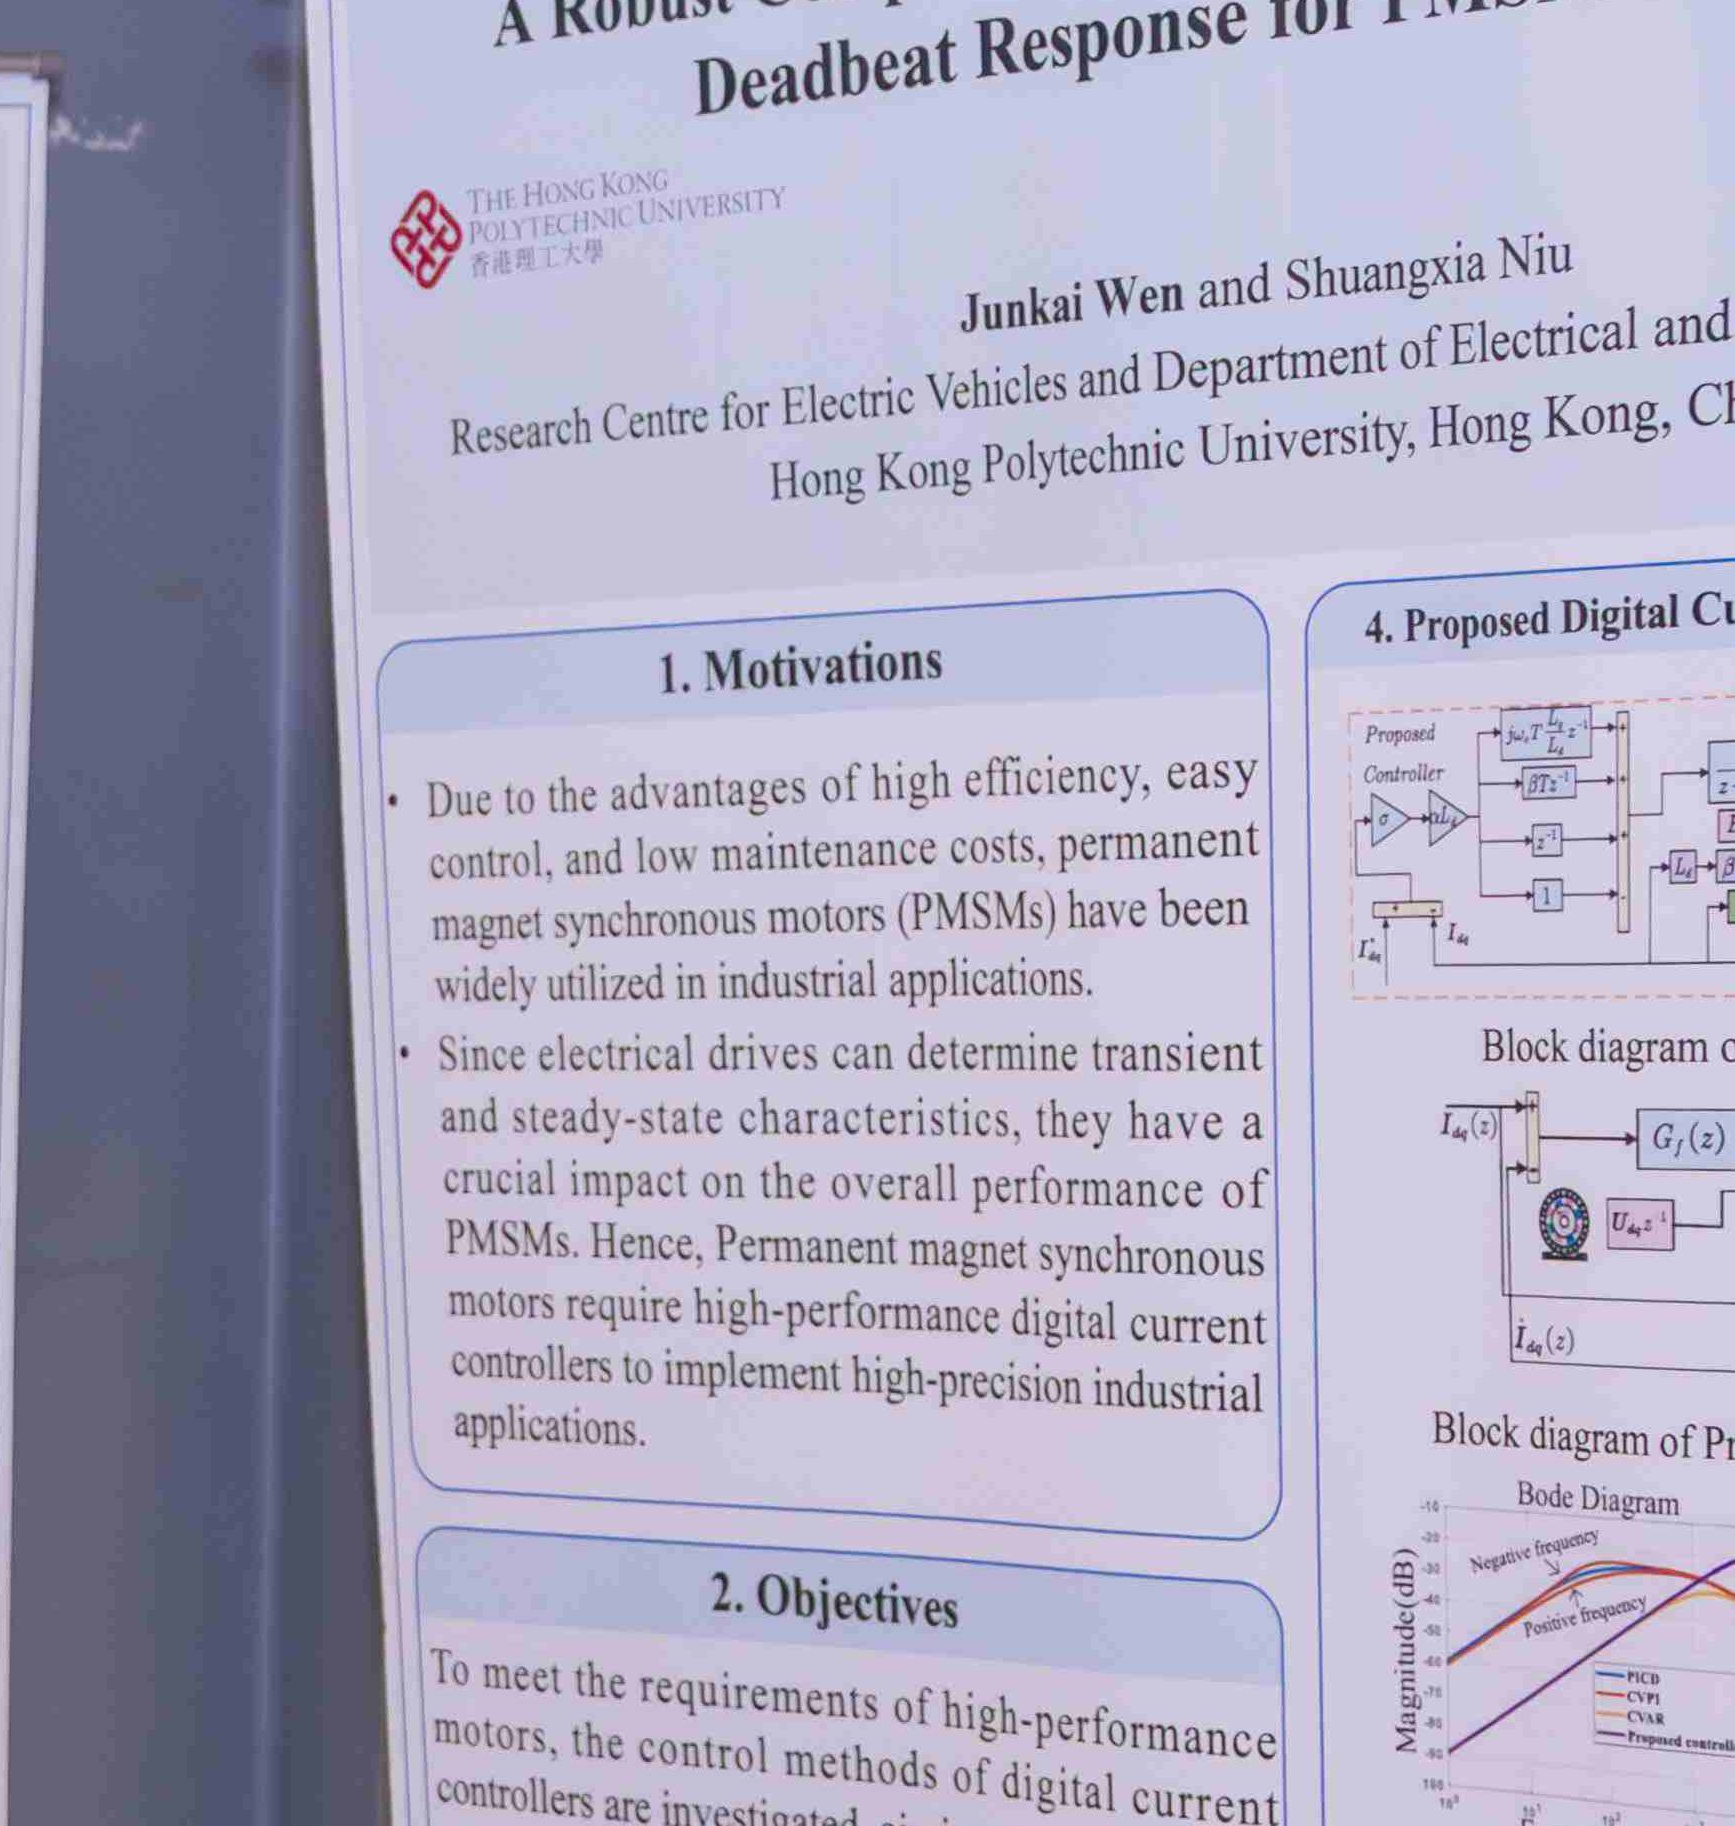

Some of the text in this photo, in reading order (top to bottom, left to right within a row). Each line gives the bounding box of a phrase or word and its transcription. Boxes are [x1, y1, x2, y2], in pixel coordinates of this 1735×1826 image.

[694, 4, 1239, 115] Deadbeat Response
[465, 169, 668, 215] THE HONG KONG
[469, 186, 786, 246] POLYTECHNIC UNIVERSITY
[961, 232, 1573, 333] Junkai Wen and Shuangxia Niu
[771, 394, 1671, 505] Hong Kong Polytechnic University, Hong Kong,
[661, 640, 942, 693] 1. Motivations
[1518, 1480, 1679, 1520] Bode Diagram
[1470, 1530, 1599, 1573] Negative frequency
[712, 1572, 958, 1630] 2. Objectives
[1392, 1547, 1422, 1753] Magnitude(dB)
